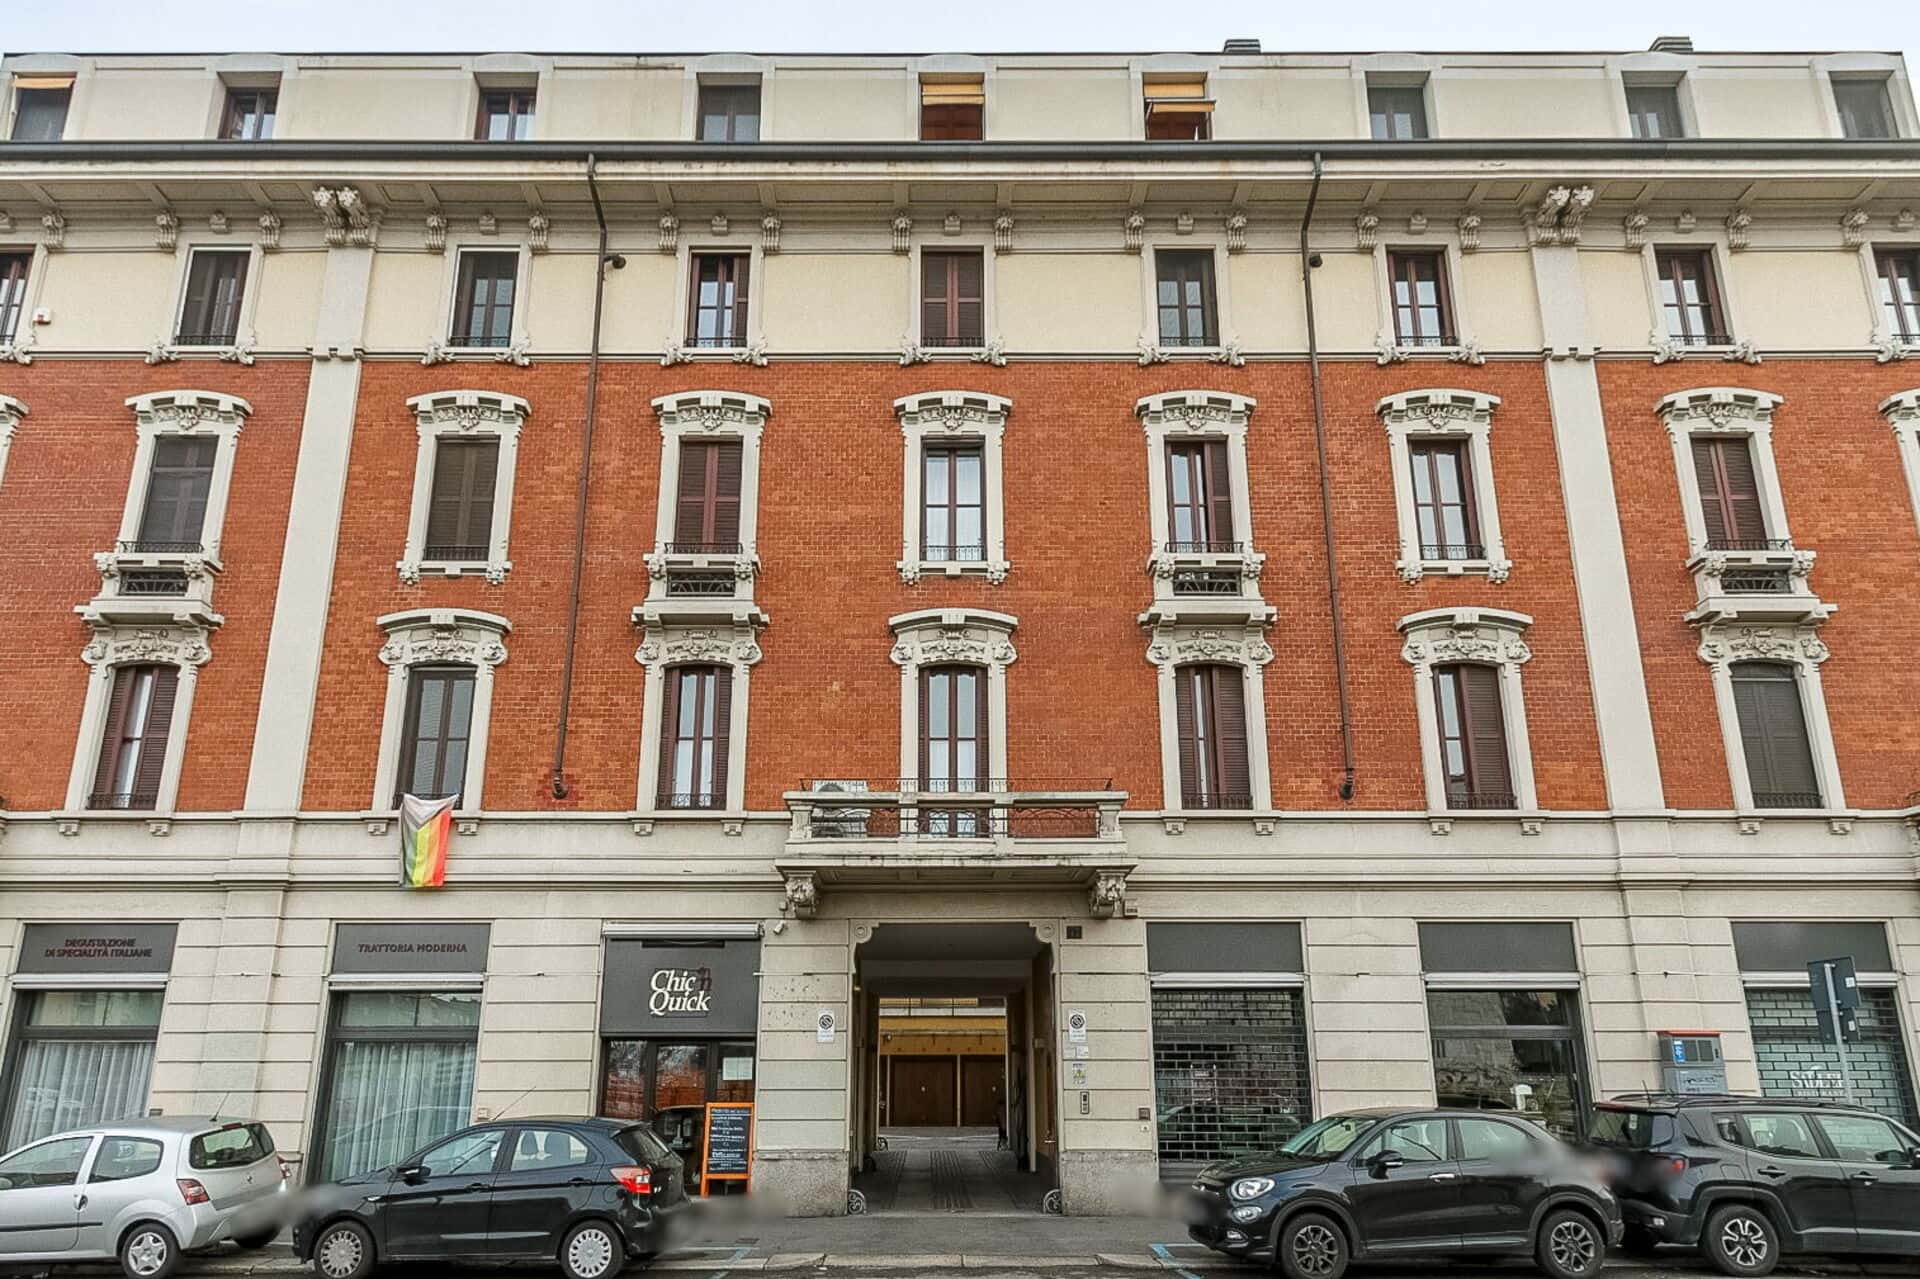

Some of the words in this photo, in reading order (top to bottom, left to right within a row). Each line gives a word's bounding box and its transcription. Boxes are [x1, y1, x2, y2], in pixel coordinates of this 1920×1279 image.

[64, 938, 137, 948] DEGUSTAZIONE
[358, 943, 415, 953] TRATTORIA
[416, 943, 468, 953] MODERNA
[45, 948, 56, 958] DI
[110, 948, 153, 958] ITALIANE
[650, 969, 697, 992] Chic
[649, 990, 712, 1016] Quick
